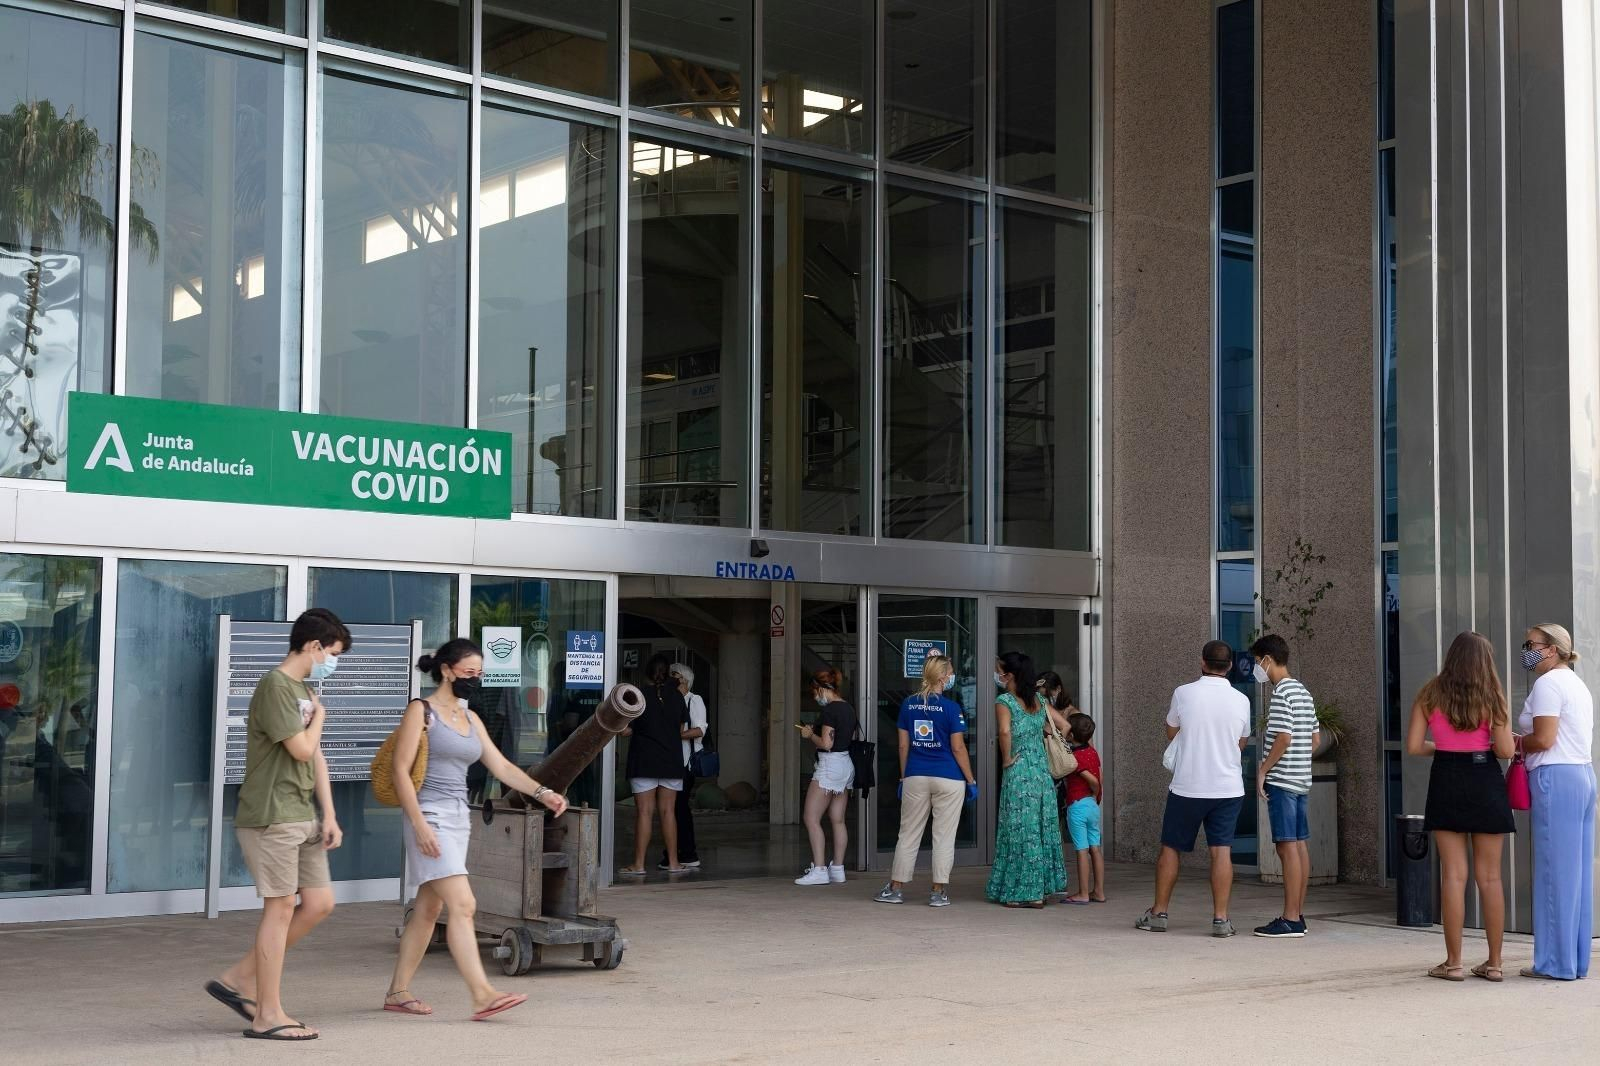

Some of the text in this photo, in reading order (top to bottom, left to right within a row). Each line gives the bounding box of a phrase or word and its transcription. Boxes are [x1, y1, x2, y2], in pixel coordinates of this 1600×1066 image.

[142, 432, 194, 451] Junta
[291, 430, 502, 476] VACUNACIÓN
[142, 453, 254, 476] de Andalucía
[351, 470, 449, 504] COVID
[716, 561, 796, 580] ENTRADA
